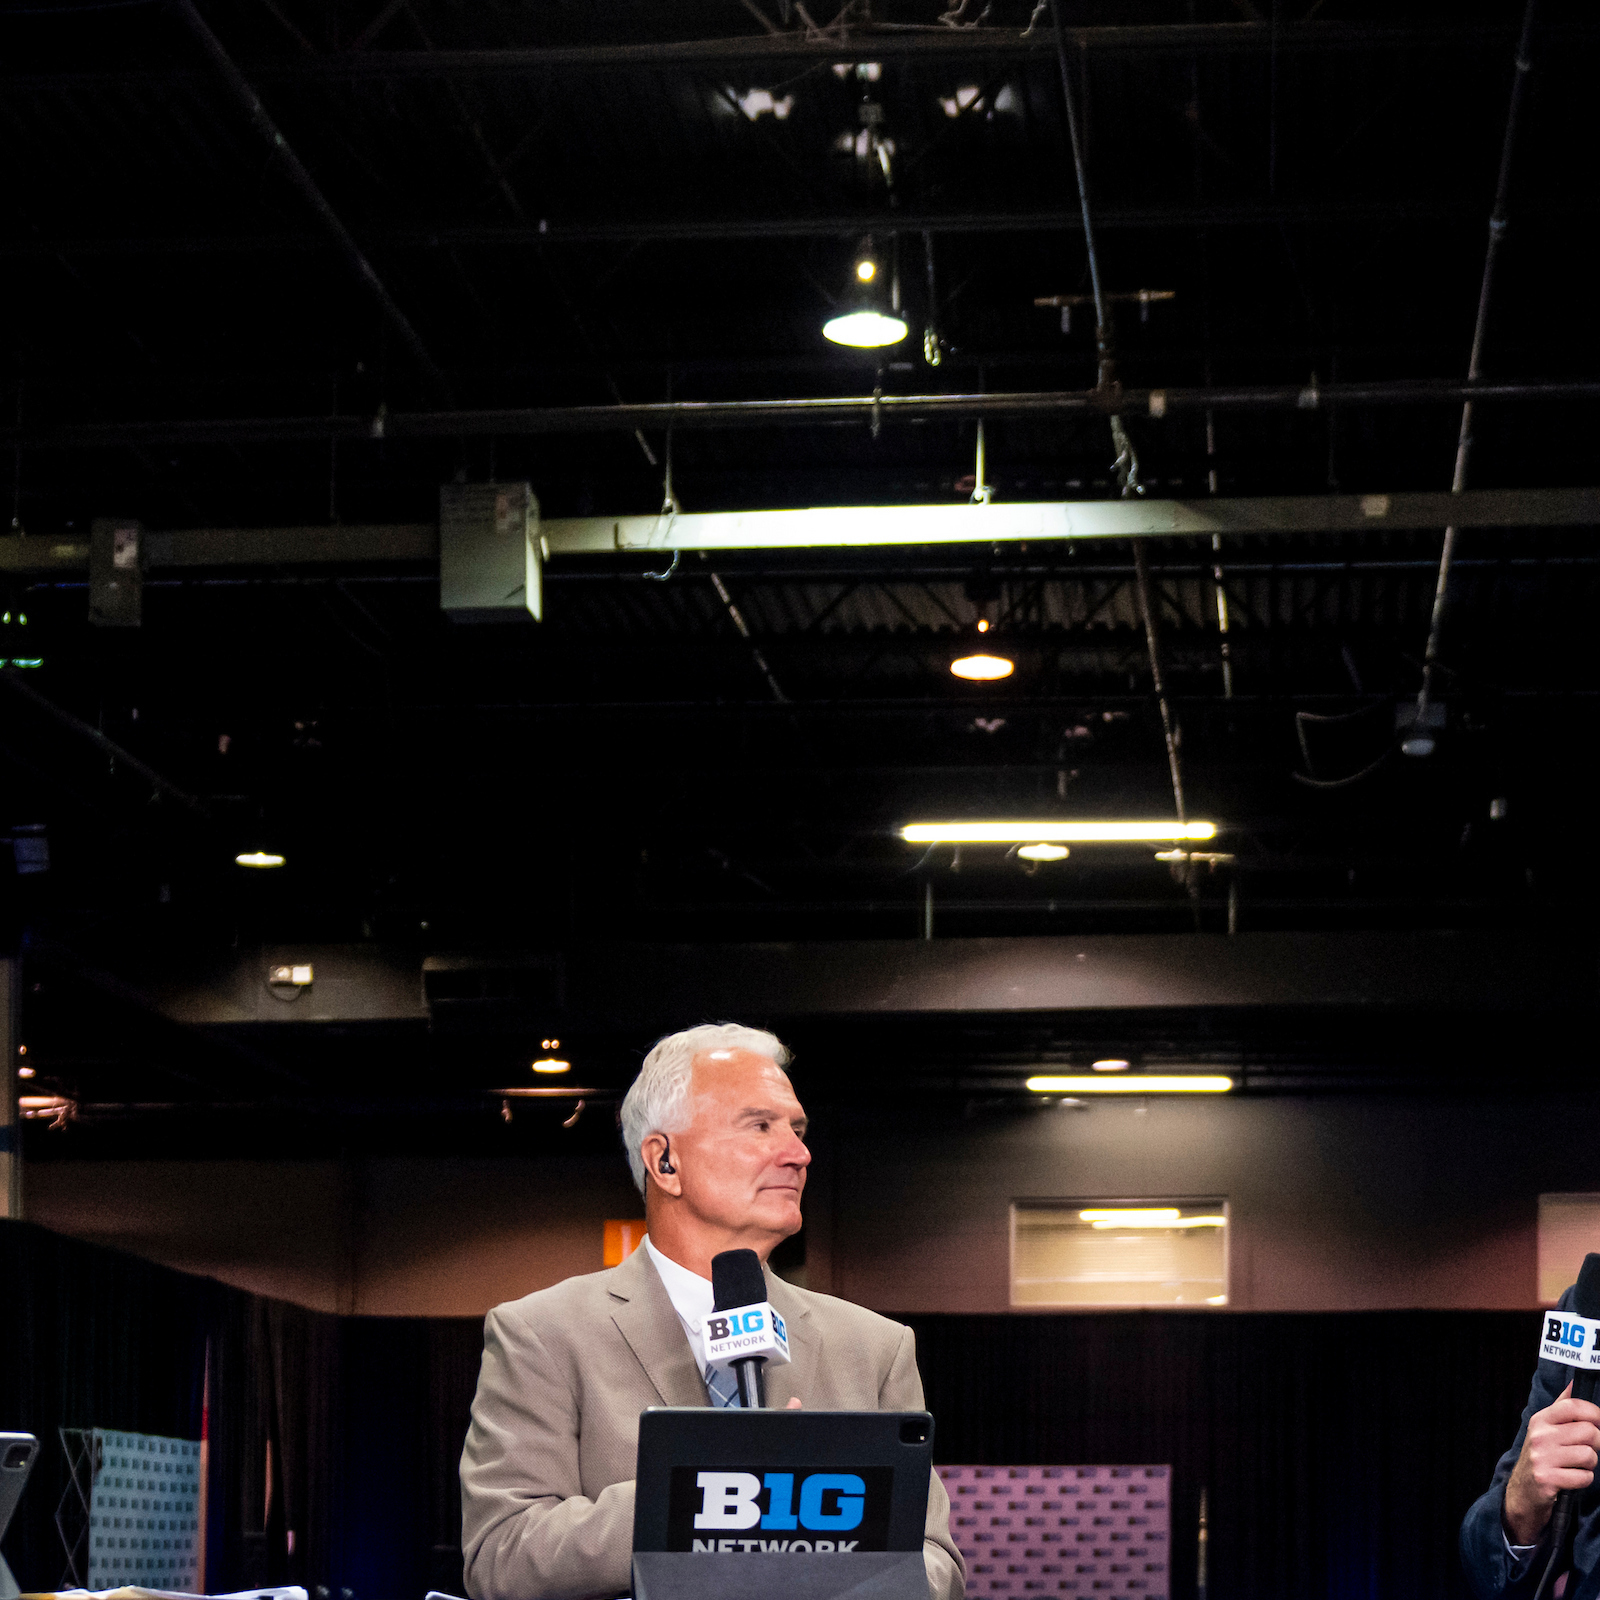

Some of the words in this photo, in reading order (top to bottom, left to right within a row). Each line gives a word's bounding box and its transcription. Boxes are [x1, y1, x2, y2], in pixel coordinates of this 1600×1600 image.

[707, 1310, 764, 1341] B1G
[1546, 1318, 1585, 1348] B1G
[710, 1334, 766, 1353] NETWORK
[1543, 1344, 1583, 1361] NETWORK
[694, 1472, 866, 1531] B1G
